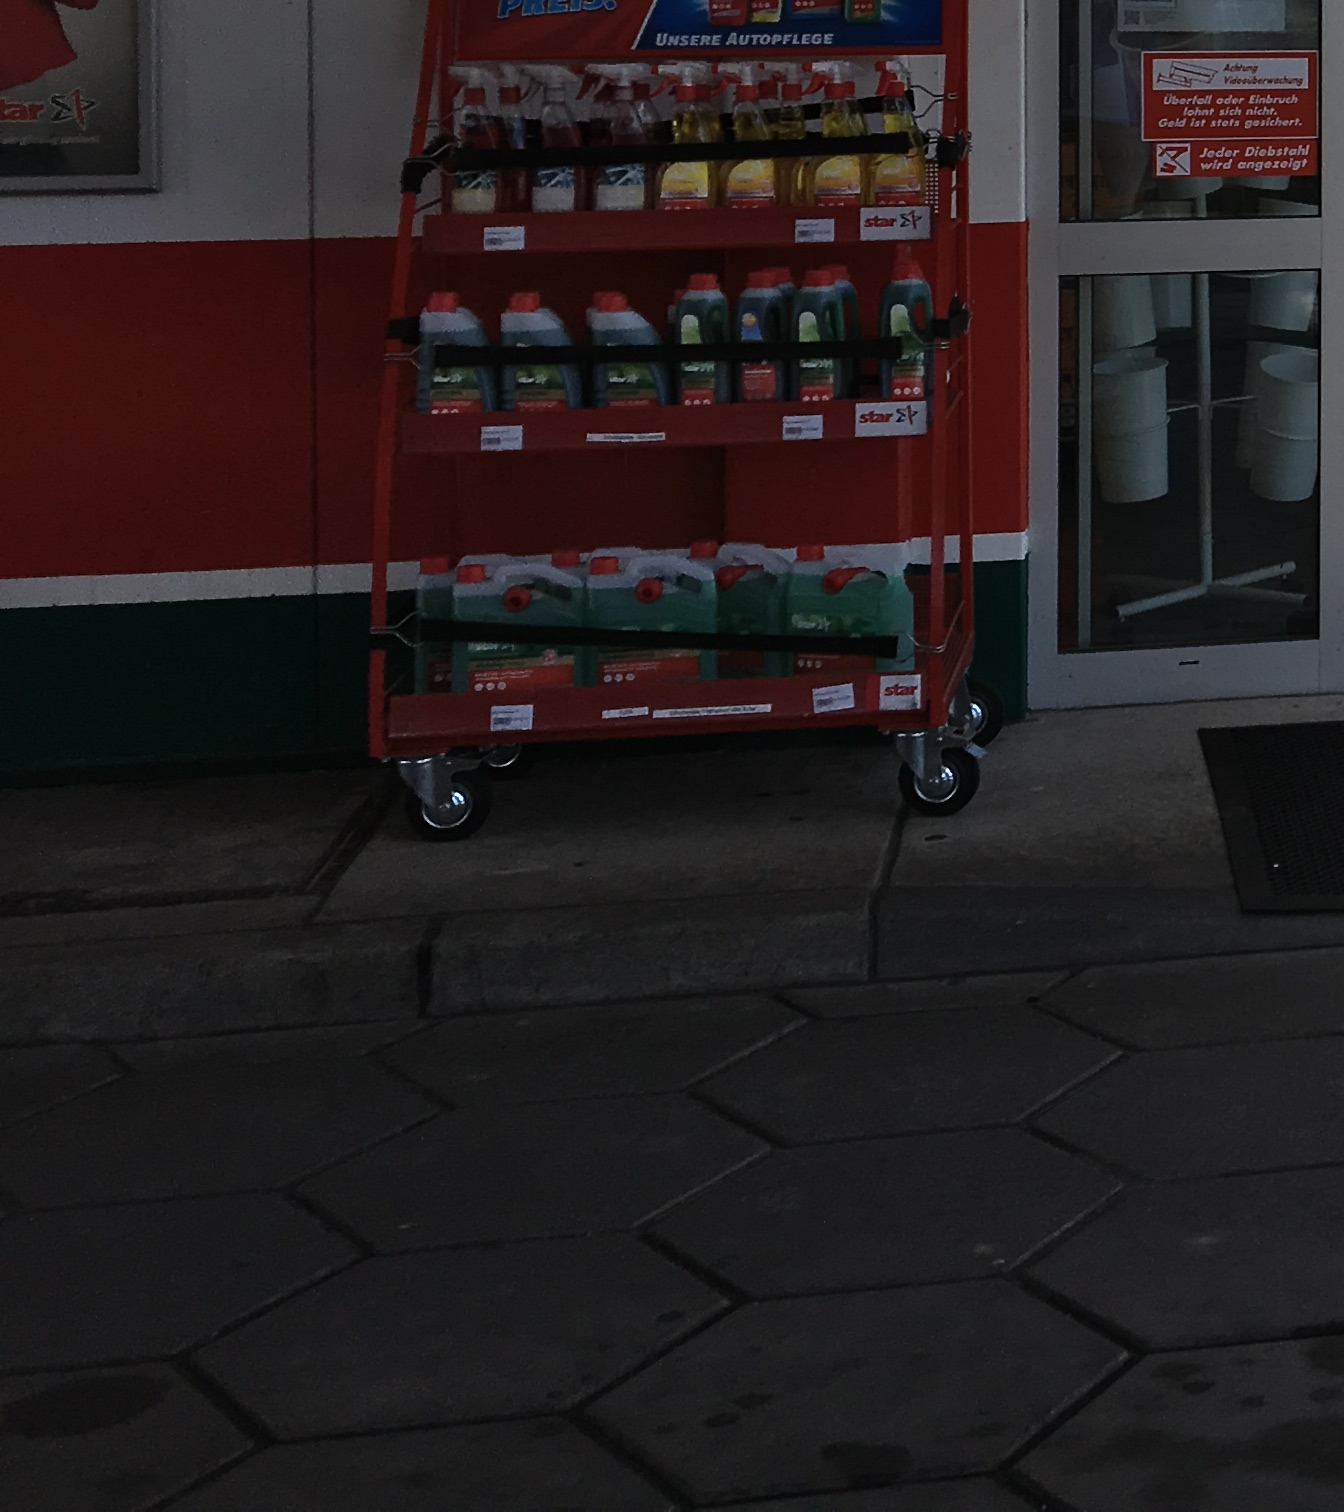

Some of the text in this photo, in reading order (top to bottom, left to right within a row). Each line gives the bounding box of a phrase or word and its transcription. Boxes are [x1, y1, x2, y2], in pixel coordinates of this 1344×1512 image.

[654, 31, 834, 47] UNSERE AUTOPFLEGE
[1223, 63, 1259, 75] Achtung
[1223, 74, 1304, 87] Videoüberwachung
[1163, 93, 1299, 105] Überfall oder Einbruch
[1183, 106, 1278, 117] lohnt sich nicht.
[1158, 118, 1303, 130] Geld ist stets gesichert.
[1199, 144, 1310, 158] Jeder Diebstahl
[1200, 158, 1308, 172] wird angezeigt
[864, 215, 897, 228] star
[859, 410, 893, 424] star
[884, 683, 919, 696] star
